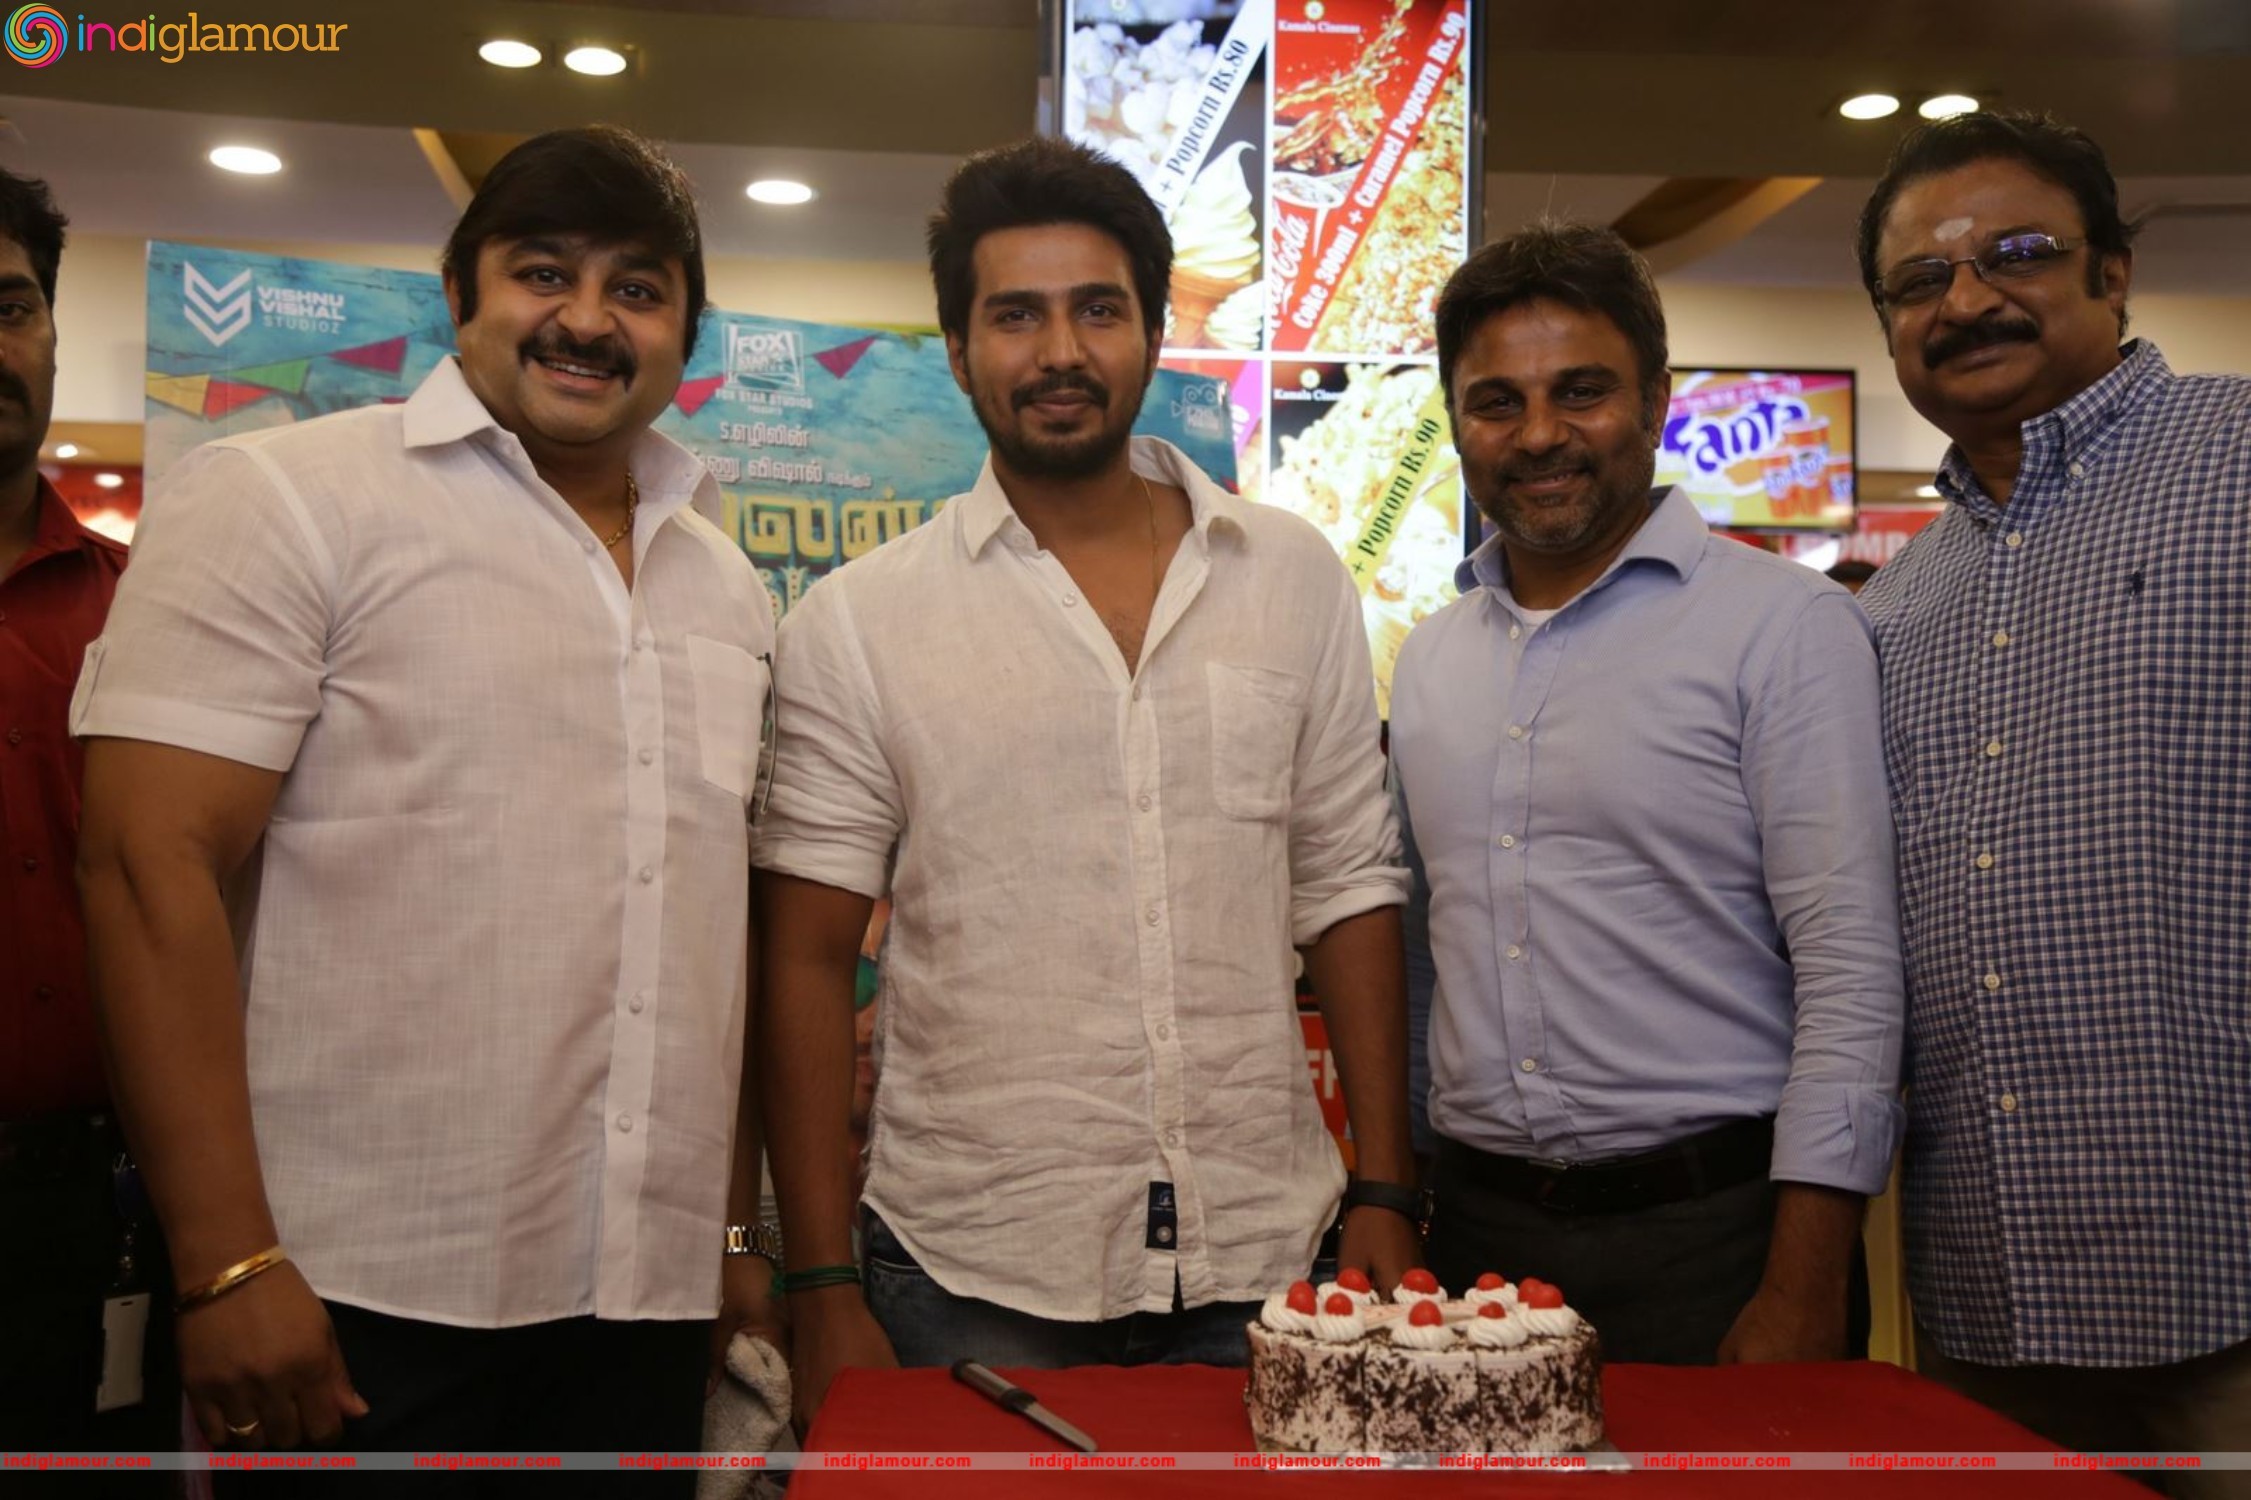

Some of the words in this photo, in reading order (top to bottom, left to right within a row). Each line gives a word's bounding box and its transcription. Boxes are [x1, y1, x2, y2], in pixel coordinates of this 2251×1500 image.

[1165, 95, 1222, 176] Popcorn
[1207, 39, 1250, 94] Rs.80
[1291, 283, 1329, 329] Coke
[1314, 224, 1359, 286] 300ml
[1354, 133, 1406, 208] Caramel
[1389, 61, 1443, 139] Popcorn
[1427, 11, 1466, 66] Rs.90
[257, 286, 344, 308] VISHNU
[258, 300, 346, 321] VISHAL
[263, 315, 340, 335] STUDIOZ
[736, 332, 787, 353] FOX
[1357, 475, 1413, 557] Popcorn
[1400, 418, 1442, 474] Rs.90
